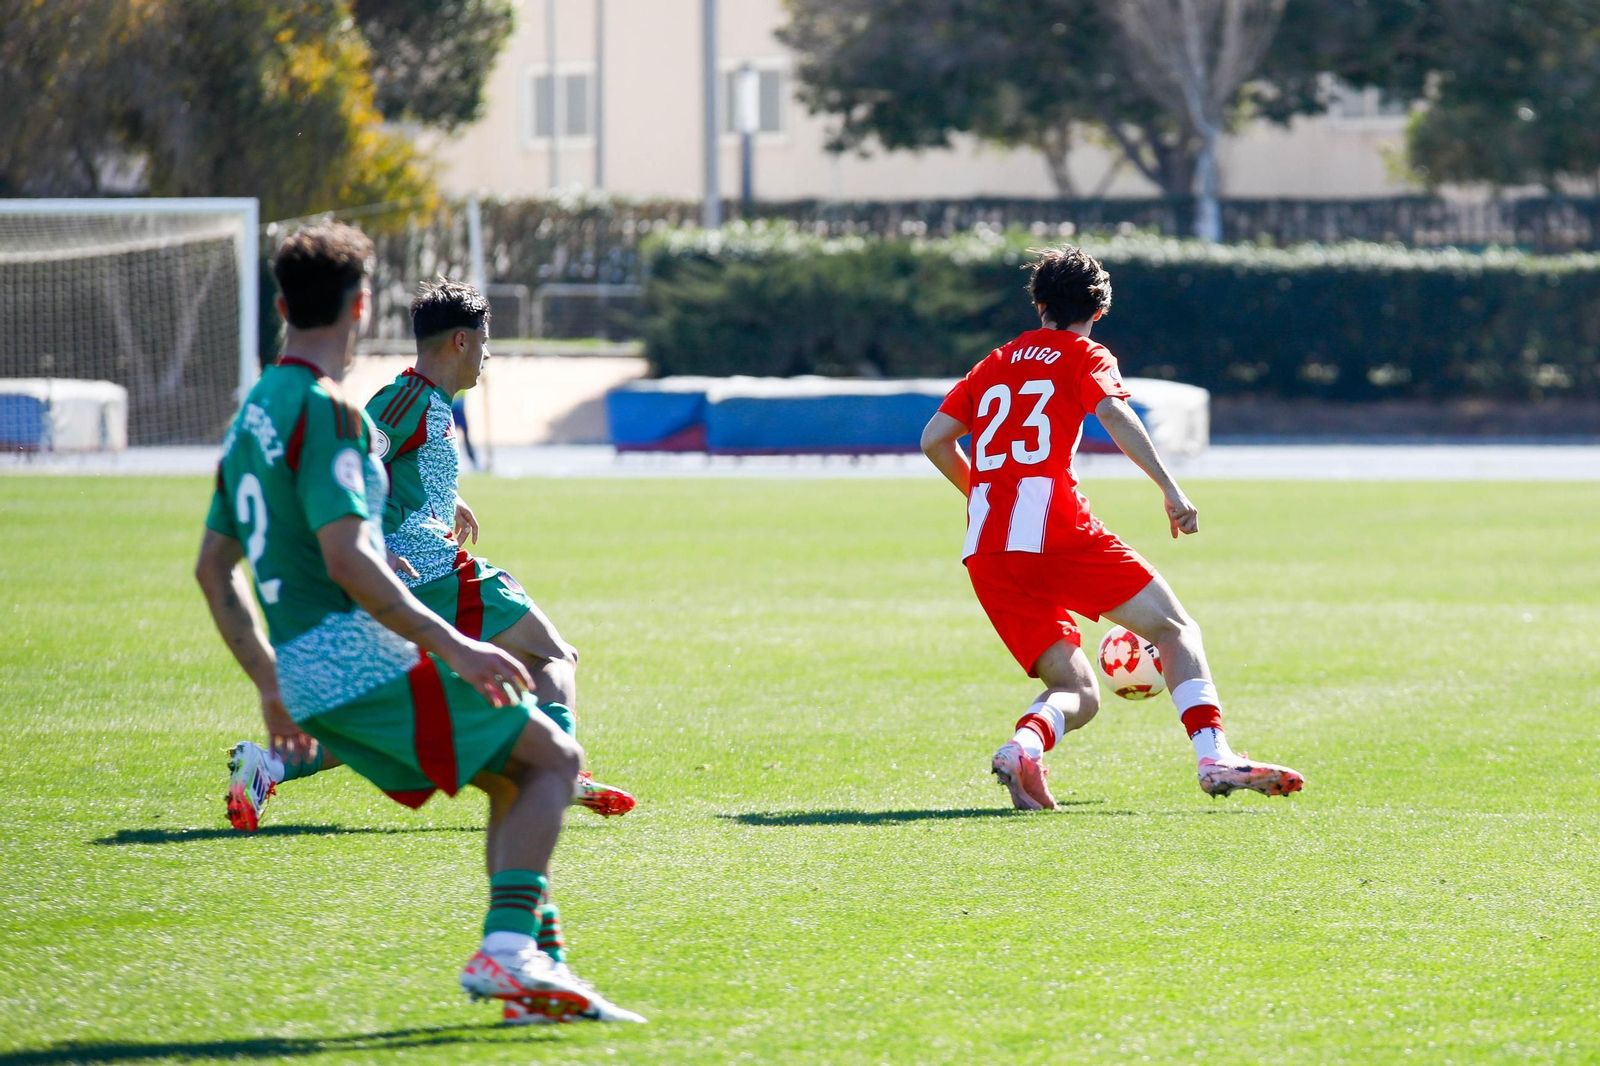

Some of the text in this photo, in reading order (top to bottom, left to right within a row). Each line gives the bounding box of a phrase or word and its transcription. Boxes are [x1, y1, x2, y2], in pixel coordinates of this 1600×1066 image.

[1010, 346, 1062, 365] HUGO
[975, 379, 1055, 472] 23
[235, 473, 282, 604] 2
